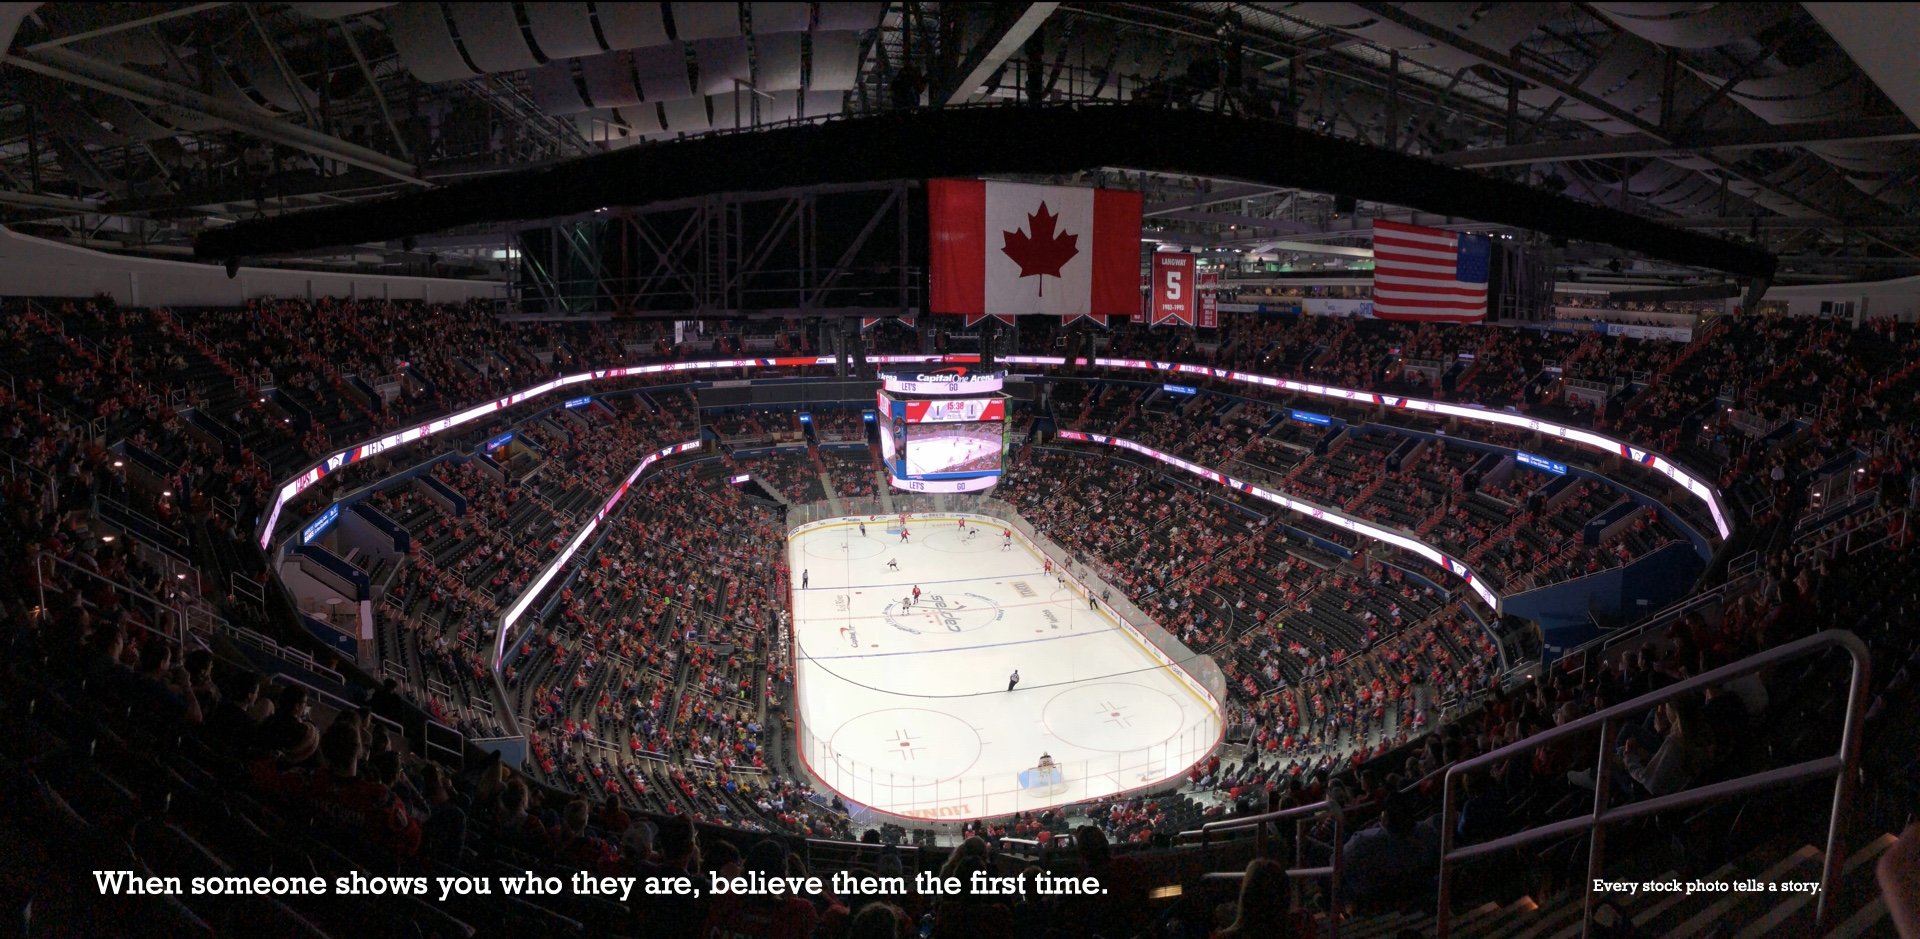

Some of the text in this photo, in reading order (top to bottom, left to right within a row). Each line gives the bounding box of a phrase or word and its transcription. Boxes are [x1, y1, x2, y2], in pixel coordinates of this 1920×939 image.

[1166, 271, 1181, 300] 5
[970, 374, 994, 383] Arena
[901, 382, 958, 391] LET'S GO
[947, 402, 964, 410] 15:38
[909, 481, 965, 490] LET'S GO
